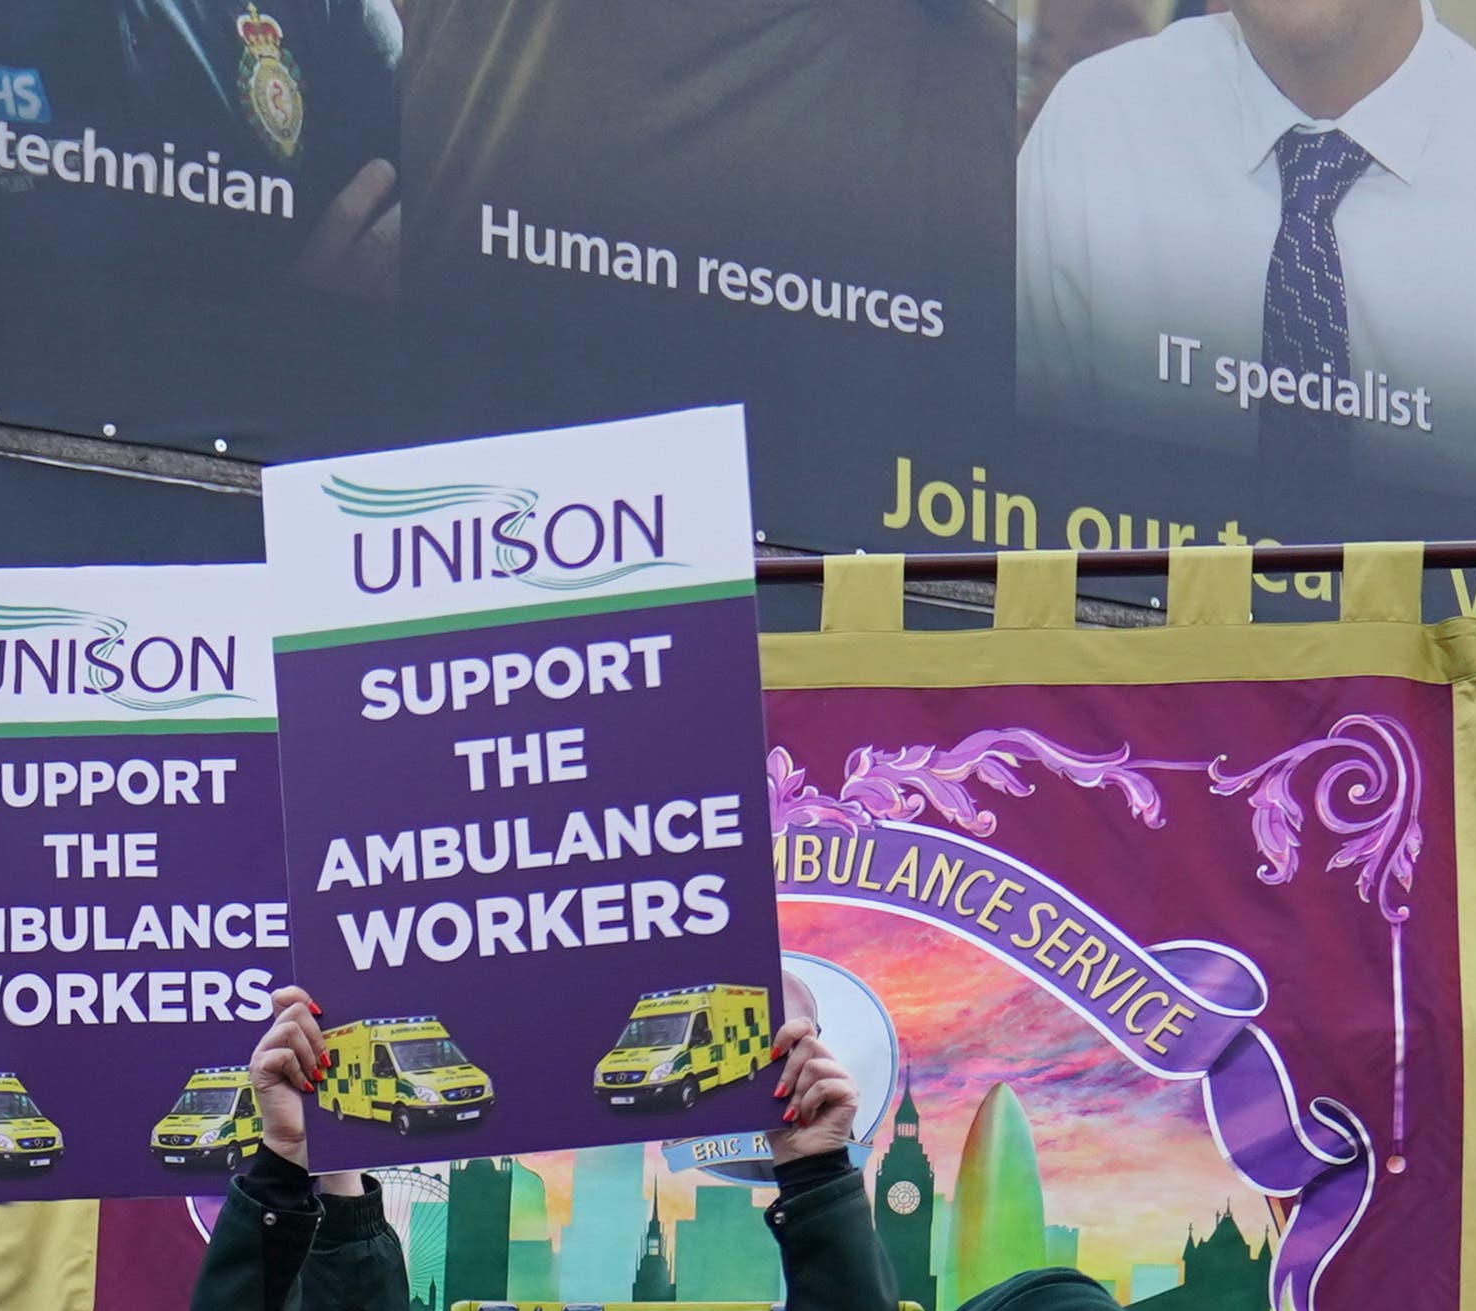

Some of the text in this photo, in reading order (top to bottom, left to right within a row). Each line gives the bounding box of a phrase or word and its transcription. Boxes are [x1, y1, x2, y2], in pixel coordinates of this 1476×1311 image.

[481, 204, 944, 338] Human resources
[1158, 333, 1433, 432] IT specialist
[353, 493, 664, 594] UNISON
[883, 457, 1037, 550] Join
[1066, 506, 1195, 550] our
[360, 635, 671, 720] SUPPORT
[455, 728, 587, 790] THE
[44, 834, 157, 878] THE
[317, 796, 743, 892] AMBULANCE
[337, 874, 730, 971] WORKERS
[1010, 903, 1196, 1055] SERVICE
[692, 1135, 741, 1160] ERIC
